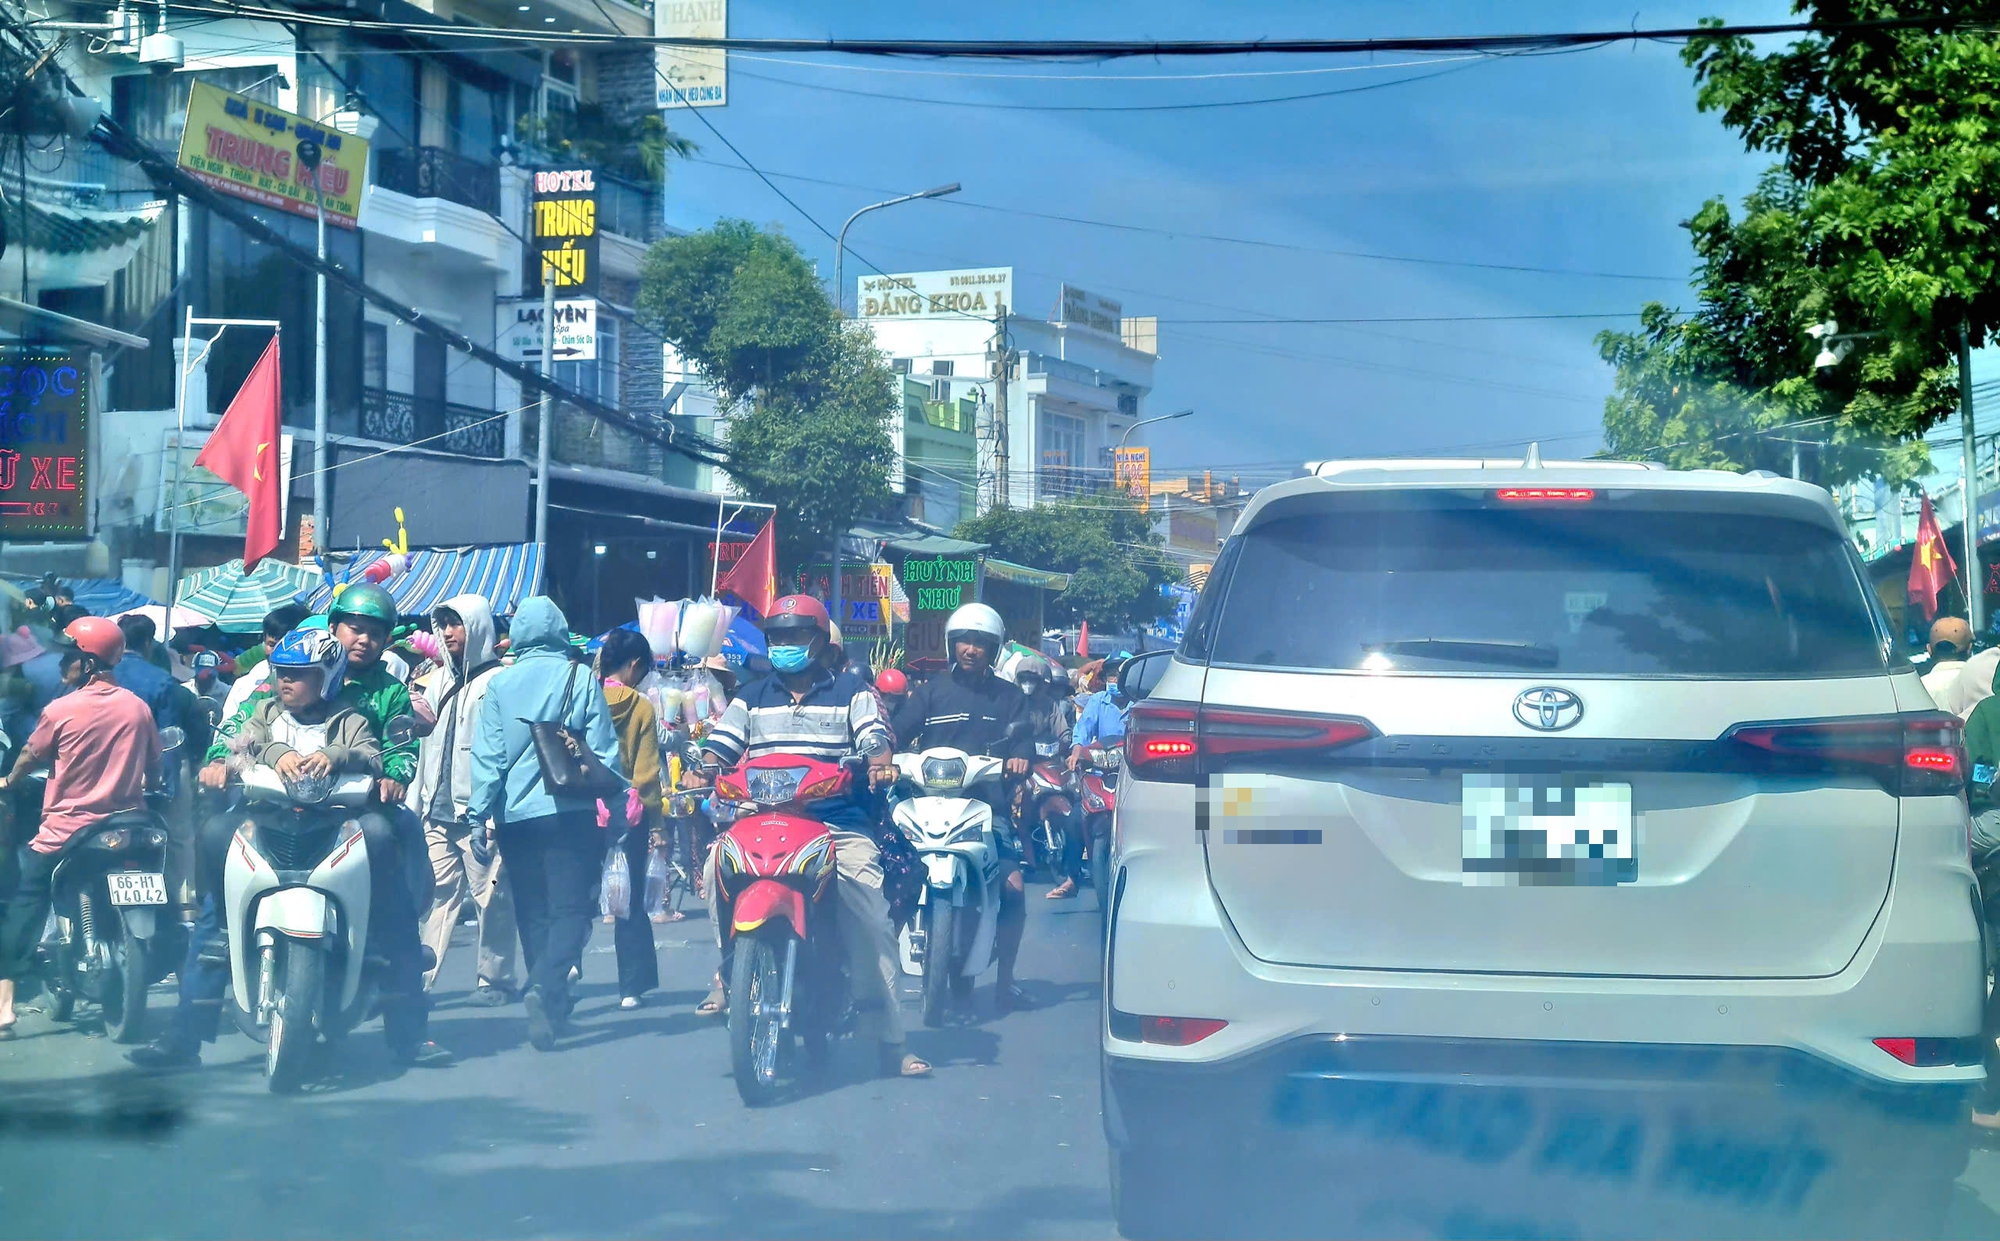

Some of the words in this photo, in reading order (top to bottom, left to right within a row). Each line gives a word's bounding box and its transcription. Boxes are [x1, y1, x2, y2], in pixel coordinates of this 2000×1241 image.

[207, 124, 292, 180] TRUNG
[296, 155, 350, 197] HẾU
[535, 170, 595, 193] HOTEL
[534, 200, 595, 237] TRUNG
[542, 239, 586, 286] HIẾU
[877, 277, 916, 291] HOTEL
[865, 292, 922, 316] ĐĂNG
[929, 292, 987, 313] KHOA
[30, 457, 76, 490] XE
[905, 555, 975, 583] HUỲNH
[917, 585, 962, 610] NHƯ
[851, 600, 879, 620] XE
[116, 876, 154, 889] 66-H1
[113, 889, 164, 903] 140.42
